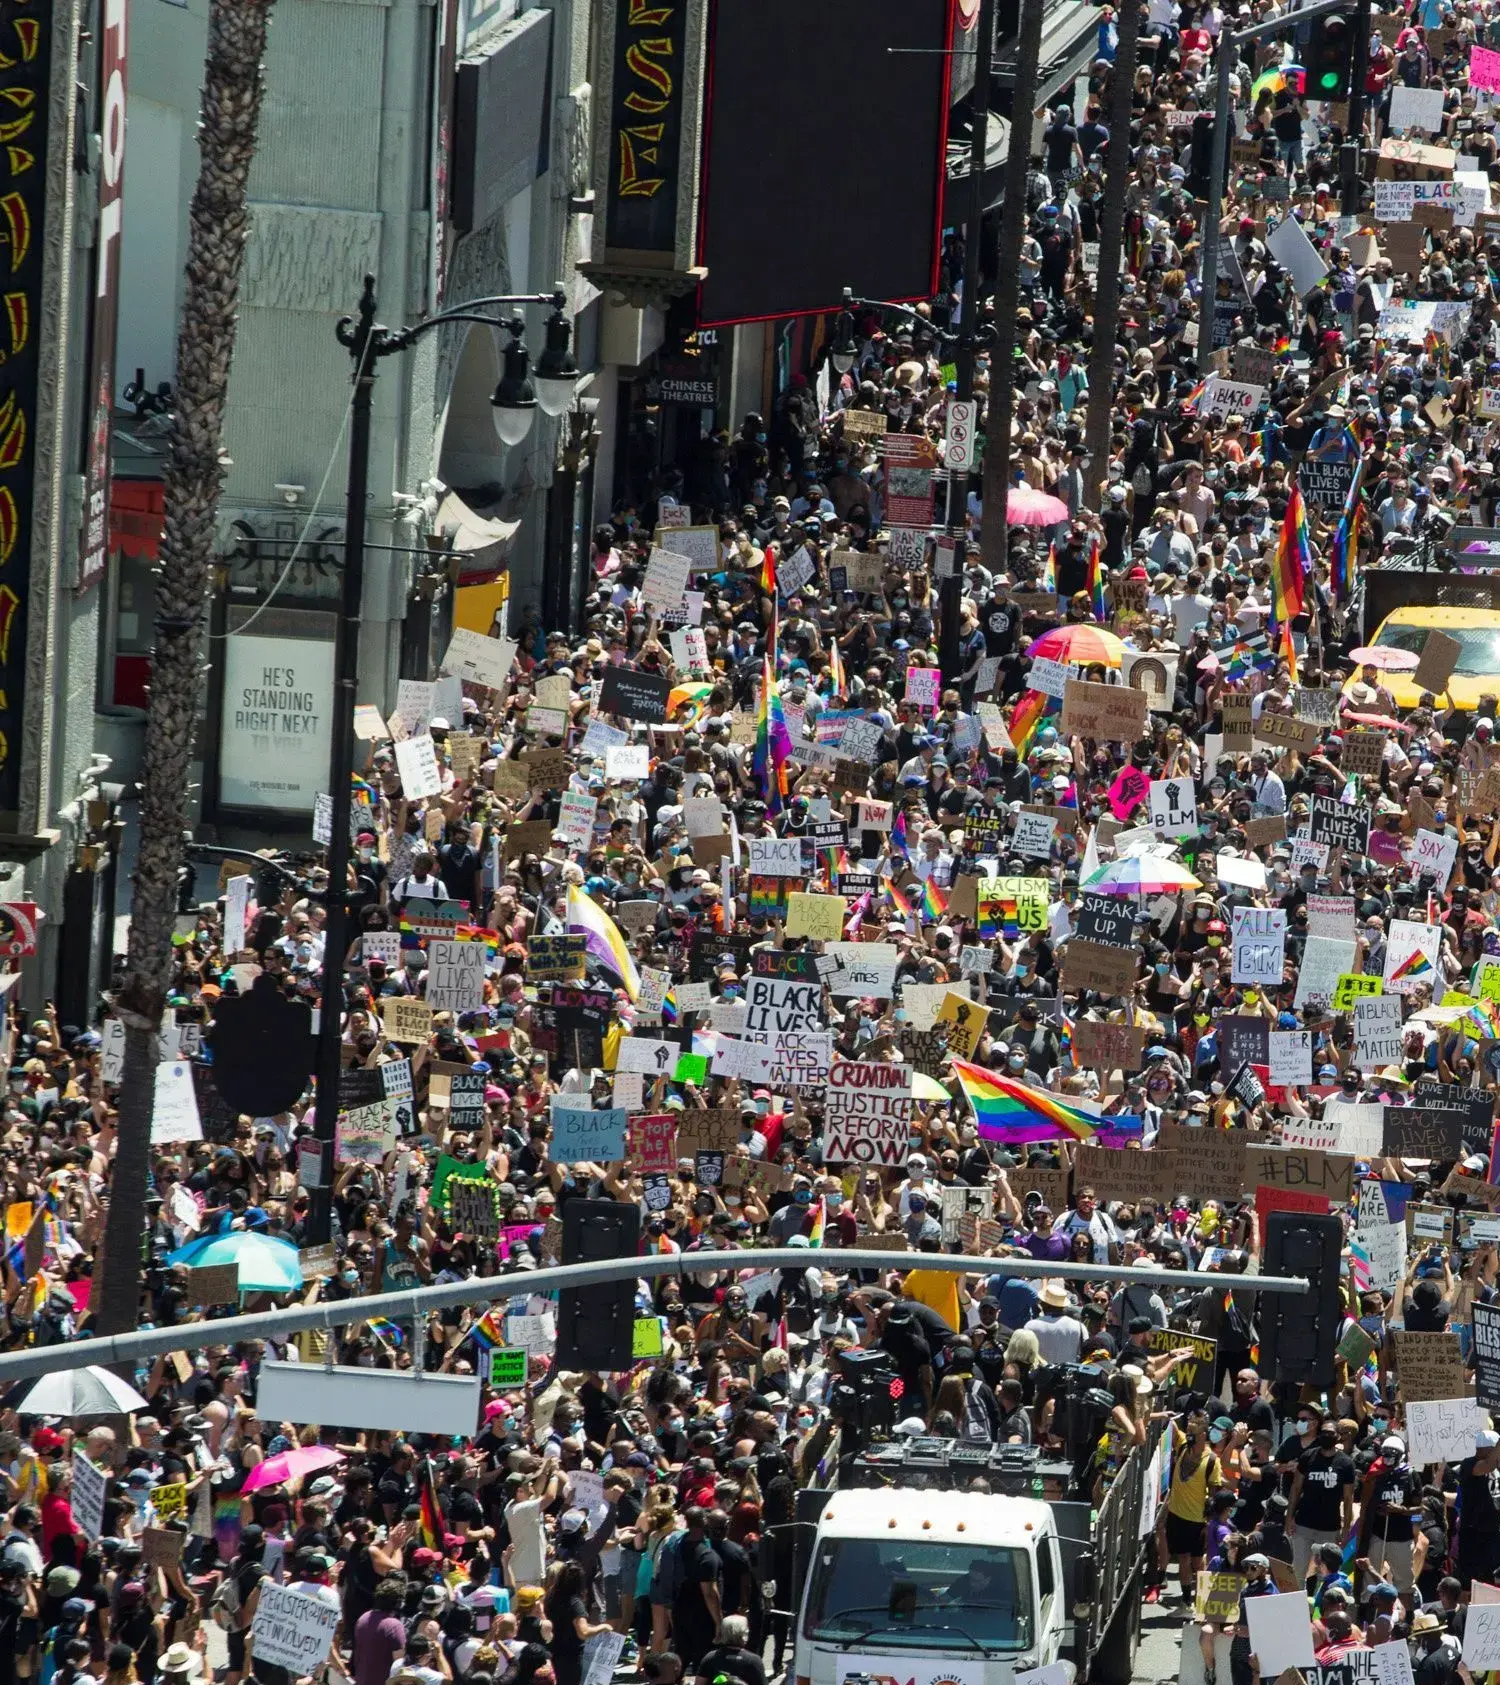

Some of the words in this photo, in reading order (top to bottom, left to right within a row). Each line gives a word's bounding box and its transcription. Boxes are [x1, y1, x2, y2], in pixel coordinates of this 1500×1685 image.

[1169, 113, 1193, 124] BLM
[1414, 184, 1462, 198] BLACK
[1388, 298, 1417, 309] PRIDE
[698, 331, 718, 344] TCL
[662, 379, 714, 393] CHINESE
[662, 390, 714, 403] THEATRES
[1217, 388, 1245, 406] BLACK
[1299, 462, 1319, 477] ALL
[1322, 464, 1351, 477] BLACK
[1310, 477, 1340, 491] LIVES
[1302, 490, 1351, 505] MATTER
[1114, 582, 1144, 599] KING
[1114, 598, 1144, 612] PIG
[263, 668, 294, 687] HE'S
[909, 679, 937, 689] BLACK
[243, 693, 313, 711] STANDING
[1223, 694, 1251, 707] BLACK
[236, 711, 276, 730] RIGHT
[282, 716, 319, 733] NEXT
[846, 717, 882, 736] BLACK
[1261, 720, 1304, 741] BLM
[969, 807, 997, 818] ALL
[1155, 810, 1194, 828] BLM
[1315, 797, 1337, 813] ALL
[1335, 801, 1368, 823] BLACK
[966, 817, 999, 829] BLACK
[1322, 817, 1357, 835] LIVES
[966, 829, 998, 841] LIVES
[1315, 829, 1363, 853] MATTER
[752, 841, 798, 863] BLACK
[1418, 838, 1444, 856] SAY
[980, 879, 1046, 892] RACISM
[1085, 895, 1134, 920] SPEAK
[1095, 919, 1116, 934] UP,
[435, 944, 483, 965] BLACK
[757, 953, 808, 972] BLACK
[436, 964, 473, 989] LIVES
[553, 990, 608, 1007] LOVE
[753, 982, 820, 1012] BLACK
[746, 1008, 817, 1033] LIVES
[1353, 1039, 1403, 1060] MATTER
[383, 1062, 410, 1073] BLACK
[386, 1073, 410, 1083] LIVES
[452, 1074, 485, 1090] BLACK
[828, 1064, 909, 1090] CRIMINAL
[385, 1082, 411, 1093] MATTER
[1449, 1085, 1494, 1105] FUCKED
[453, 1093, 483, 1106] LIVES
[828, 1091, 909, 1115] JUSTICE
[348, 1102, 391, 1123] BLACK
[450, 1110, 484, 1125] MATTER
[1389, 1110, 1445, 1126] BLACK
[566, 1113, 621, 1134] BLACK
[828, 1115, 909, 1136] REFORM
[1399, 1127, 1447, 1144] LIVES
[827, 1135, 907, 1165] NOW
[1258, 1154, 1352, 1187] #BLM
[1359, 1181, 1380, 1201] WE
[1360, 1199, 1385, 1217] ARE
[492, 1362, 524, 1371] JUSTICE
[1412, 1403, 1481, 1422] BLM
[1309, 1470, 1337, 1481] STAND
[1324, 1478, 1337, 1488] UP
[151, 1485, 184, 1504] BLACK
[255, 1618, 277, 1637] GET
[1306, 1668, 1343, 1685] BLM
